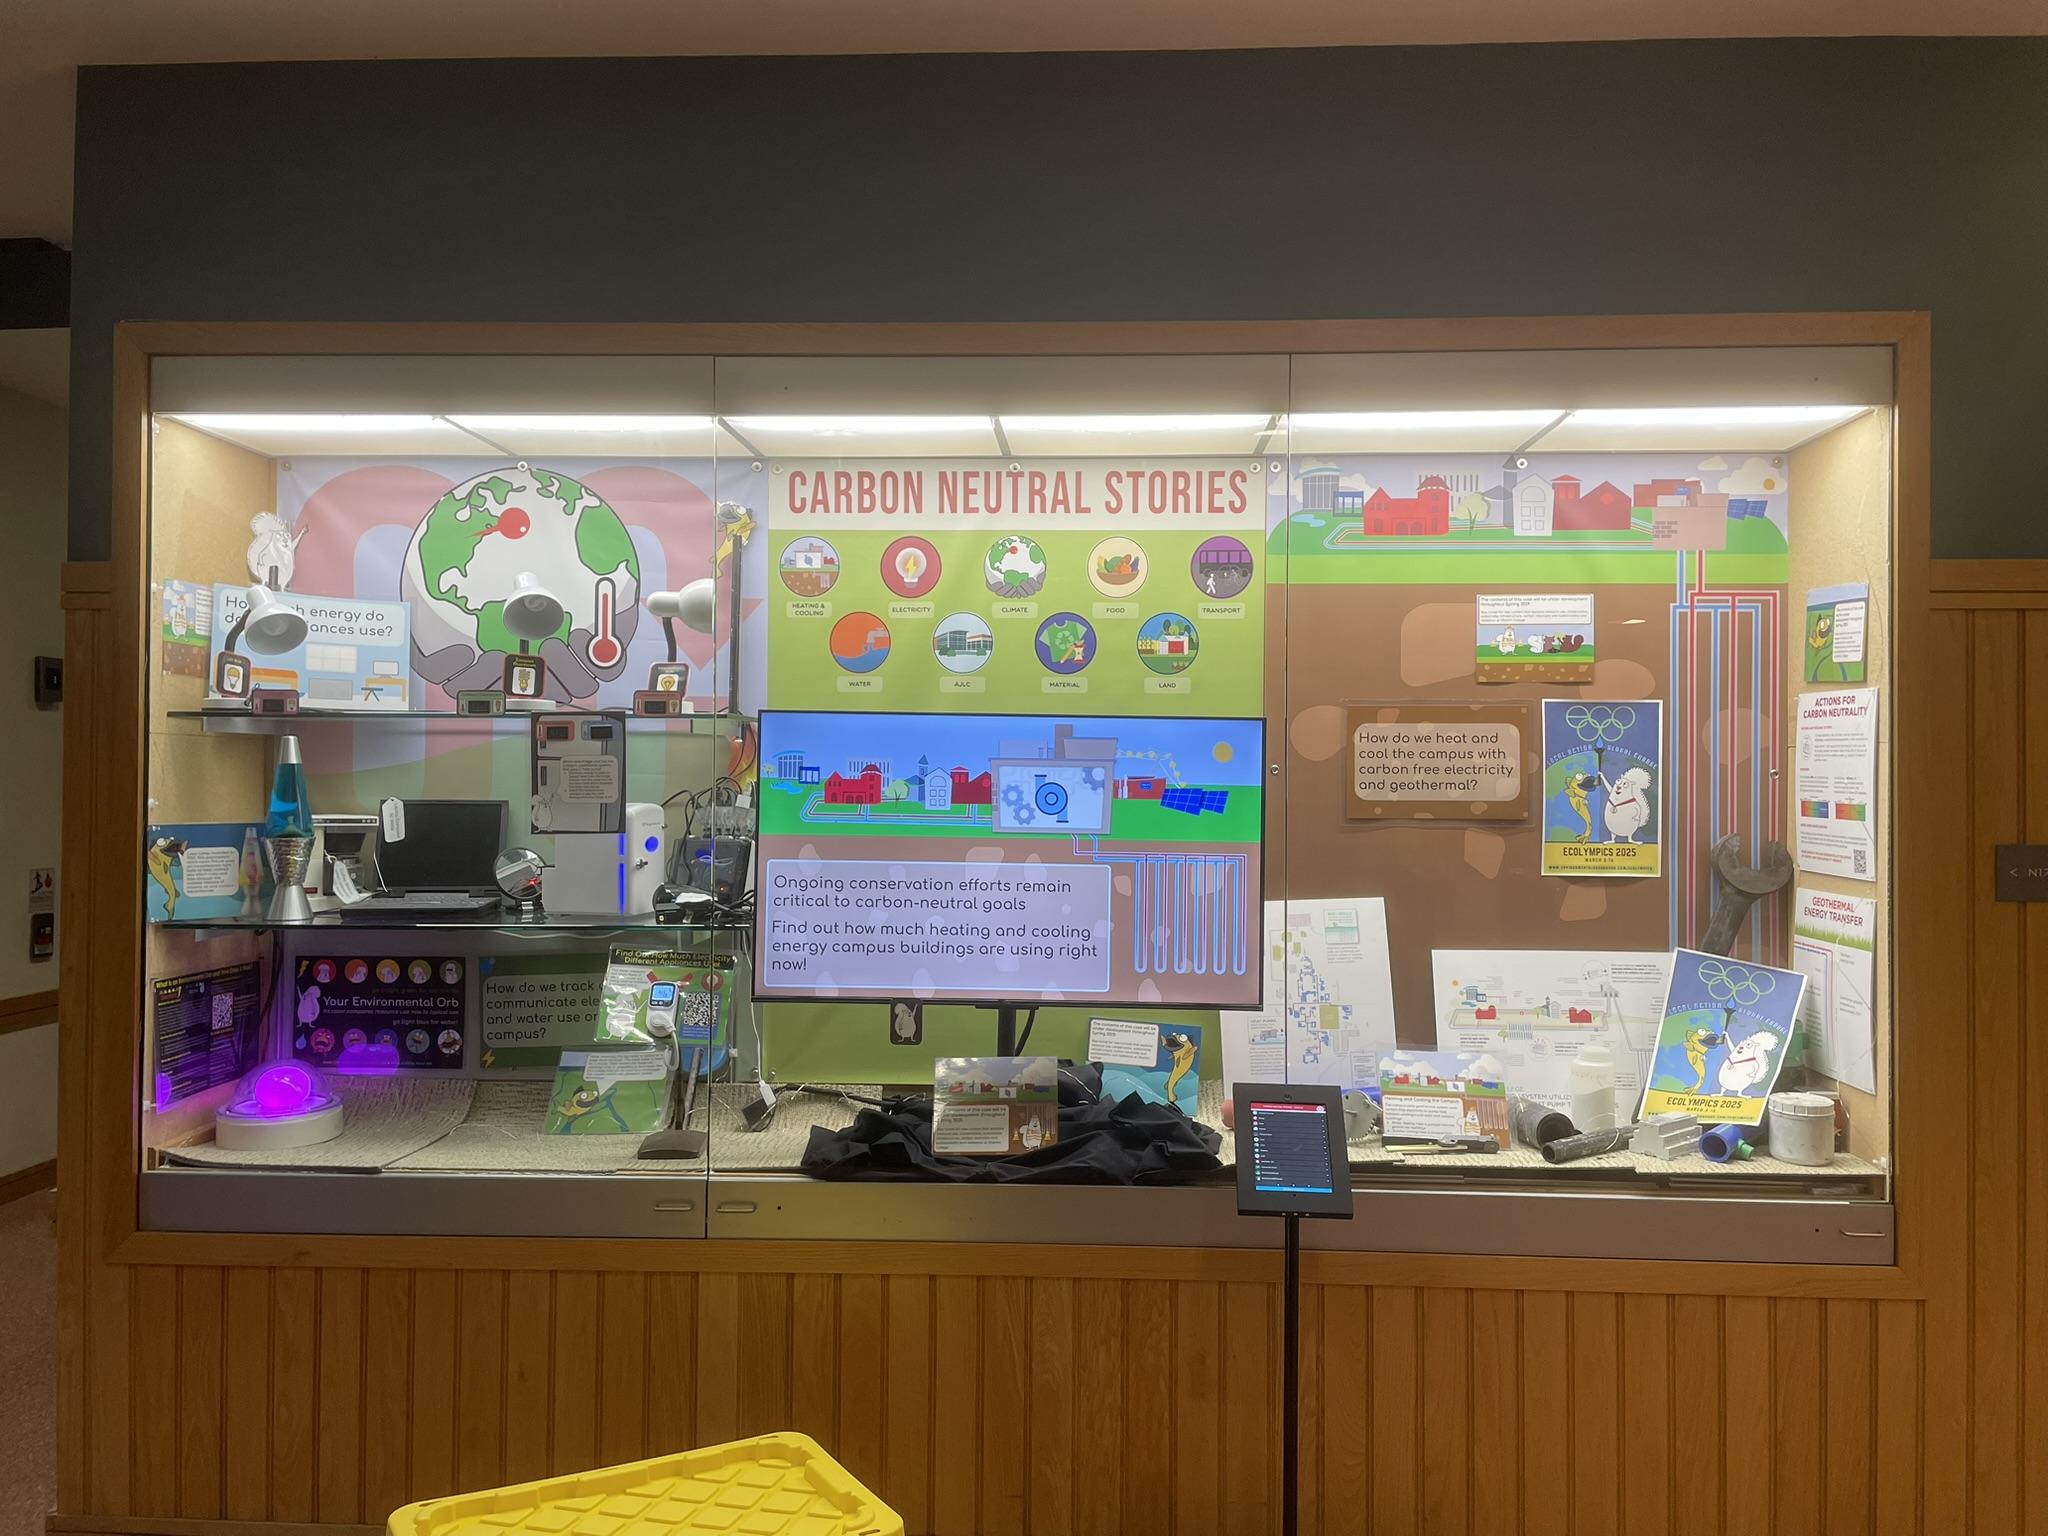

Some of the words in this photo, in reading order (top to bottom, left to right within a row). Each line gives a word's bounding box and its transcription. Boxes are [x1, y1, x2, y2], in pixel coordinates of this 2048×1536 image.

[788, 470, 923, 514] CARBON
[938, 470, 1091, 514] NEUTRAL
[1104, 469, 1248, 514] STORIES
[226, 595, 248, 609] Ho
[309, 608, 361, 622] energy
[365, 610, 384, 621] do
[309, 621, 355, 635] ances
[359, 625, 393, 637] use?
[1815, 697, 1840, 707] ACTIONS
[1842, 696, 1856, 704] FOR
[1803, 709, 1828, 718] CARBON
[1828, 706, 1868, 718] NEUTRALITY
[1359, 732, 1388, 743] How
[1392, 732, 1409, 743] do
[1414, 734, 1432, 743] we
[1436, 732, 1467, 743] heat
[1471, 732, 1498, 743] and
[1359, 748, 1388, 759] cool
[1393, 748, 1415, 759] the
[1419, 750, 1474, 761] campus
[1477, 748, 1506, 759] with
[1359, 764, 1409, 775] carbon
[1413, 764, 1440, 775] free
[1444, 764, 1513, 777] electricity
[1359, 780, 1385, 790] and
[1390, 779, 1478, 792] geothermal?
[1563, 847, 1613, 856] ECOLYMPICS
[1616, 847, 1637, 857] 2025
[774, 875, 844, 892] Ongoing
[849, 877, 953, 891] conservation
[958, 878, 1011, 892] efforts
[1016, 880, 1071, 893] remain
[773, 894, 830, 907] critical
[834, 895, 850, 907] to
[855, 895, 978, 909] carbon-neutral
[982, 898, 1026, 913] goals
[1812, 896, 1855, 913] GEOTHERMAL
[1804, 906, 1828, 920] ENERGY
[1829, 911, 1864, 927] TRANSFER
[772, 920, 808, 934] Find
[812, 922, 839, 934] out
[844, 921, 875, 935] how
[880, 922, 924, 935] much
[929, 922, 990, 939] heating
[995, 924, 1026, 937] and
[1031, 925, 1091, 941] cooling
[772, 942, 828, 956] energy
[832, 943, 895, 956] campus
[900, 941, 974, 957] buildings
[978, 945, 1005, 955] are
[1010, 943, 1054, 959] using
[1059, 943, 1098, 960] right
[659, 958, 701, 966] Appliances
[772, 957, 807, 970] now!
[486, 983, 515, 993] How
[518, 981, 536, 993] do
[539, 983, 557, 992] we
[561, 980, 594, 992] track
[323, 996, 348, 1007] Your
[353, 996, 433, 1007] Environmental
[437, 997, 459, 1007] Orb
[486, 997, 577, 1009] communicate
[581, 996, 600, 1007] ele
[486, 1013, 512, 1024] and
[517, 1013, 553, 1023] water
[557, 1013, 580, 1022] use
[486, 1027, 547, 1041] campus?
[1666, 1096, 1719, 1108] ECOLYMPICS
[1720, 1100, 1743, 1109] 2025
